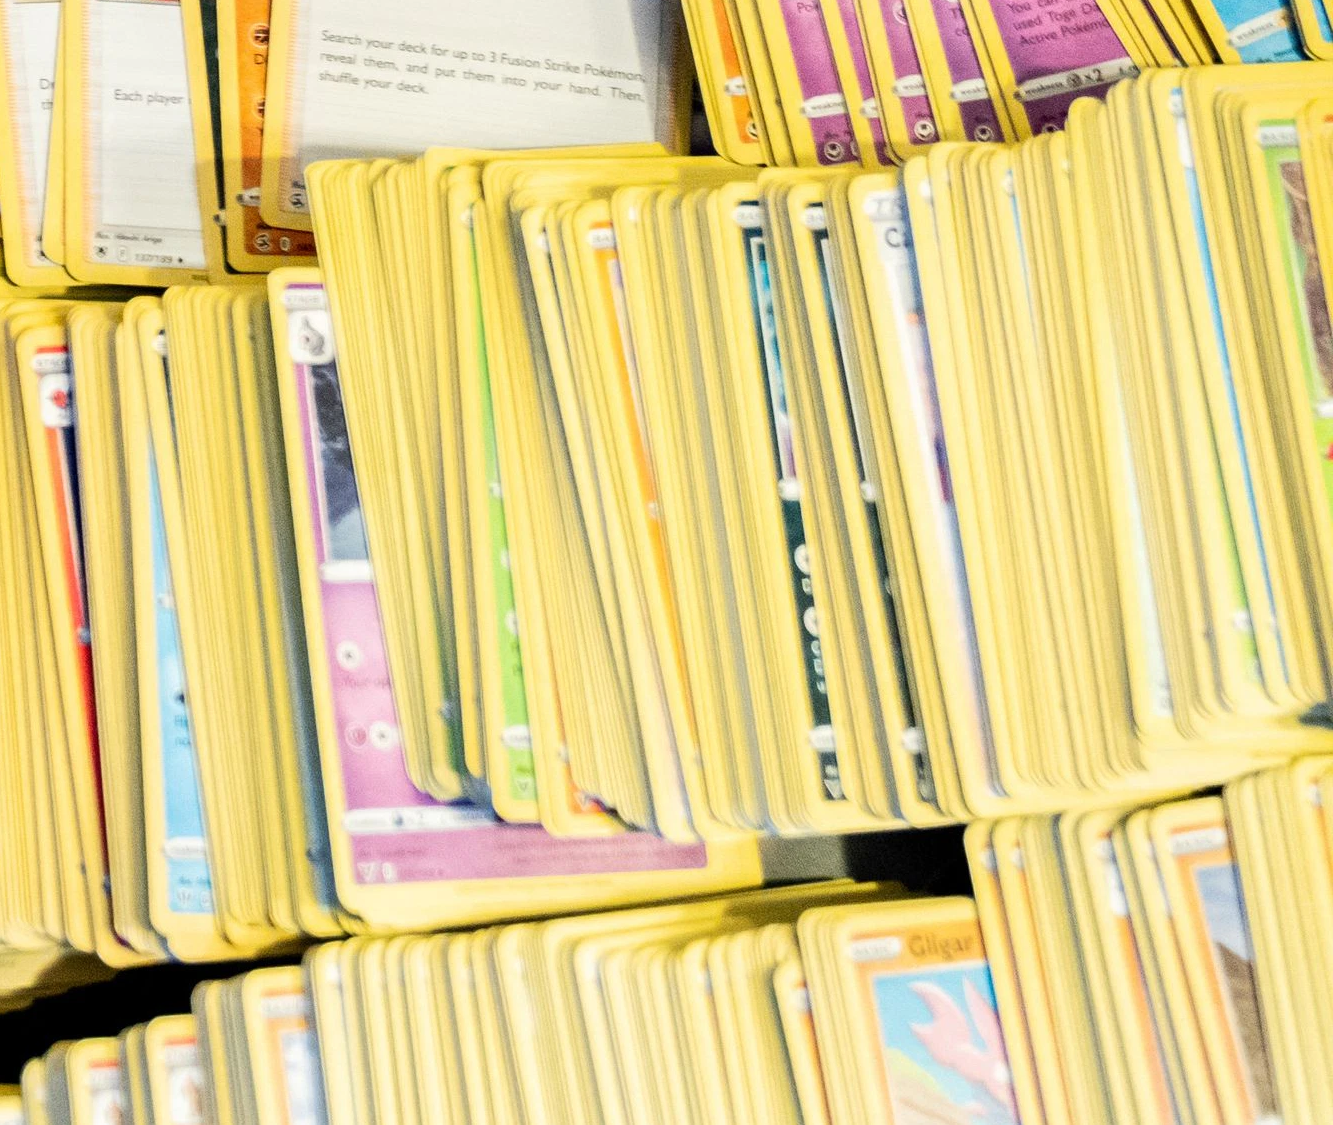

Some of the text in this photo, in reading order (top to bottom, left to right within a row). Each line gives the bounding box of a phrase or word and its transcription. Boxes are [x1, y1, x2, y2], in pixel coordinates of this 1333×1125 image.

[1060, 18, 1112, 39] Pokémo
[320, 29, 363, 47] Search
[364, 36, 395, 52] your
[397, 39, 428, 55] deck
[430, 42, 450, 57] for
[452, 47, 470, 63] up
[471, 49, 487, 63] to
[499, 52, 542, 70] Fusion
[544, 57, 582, 75] Strike
[318, 69, 430, 96] shuffle your deck.
[319, 51, 358, 65] reveal
[405, 61, 429, 75] and
[434, 66, 457, 81] put
[462, 68, 496, 84] them
[501, 73, 529, 88] into
[532, 79, 564, 94] your
[113, 88, 185, 106] Each player
[906, 932, 976, 961] Gligar
